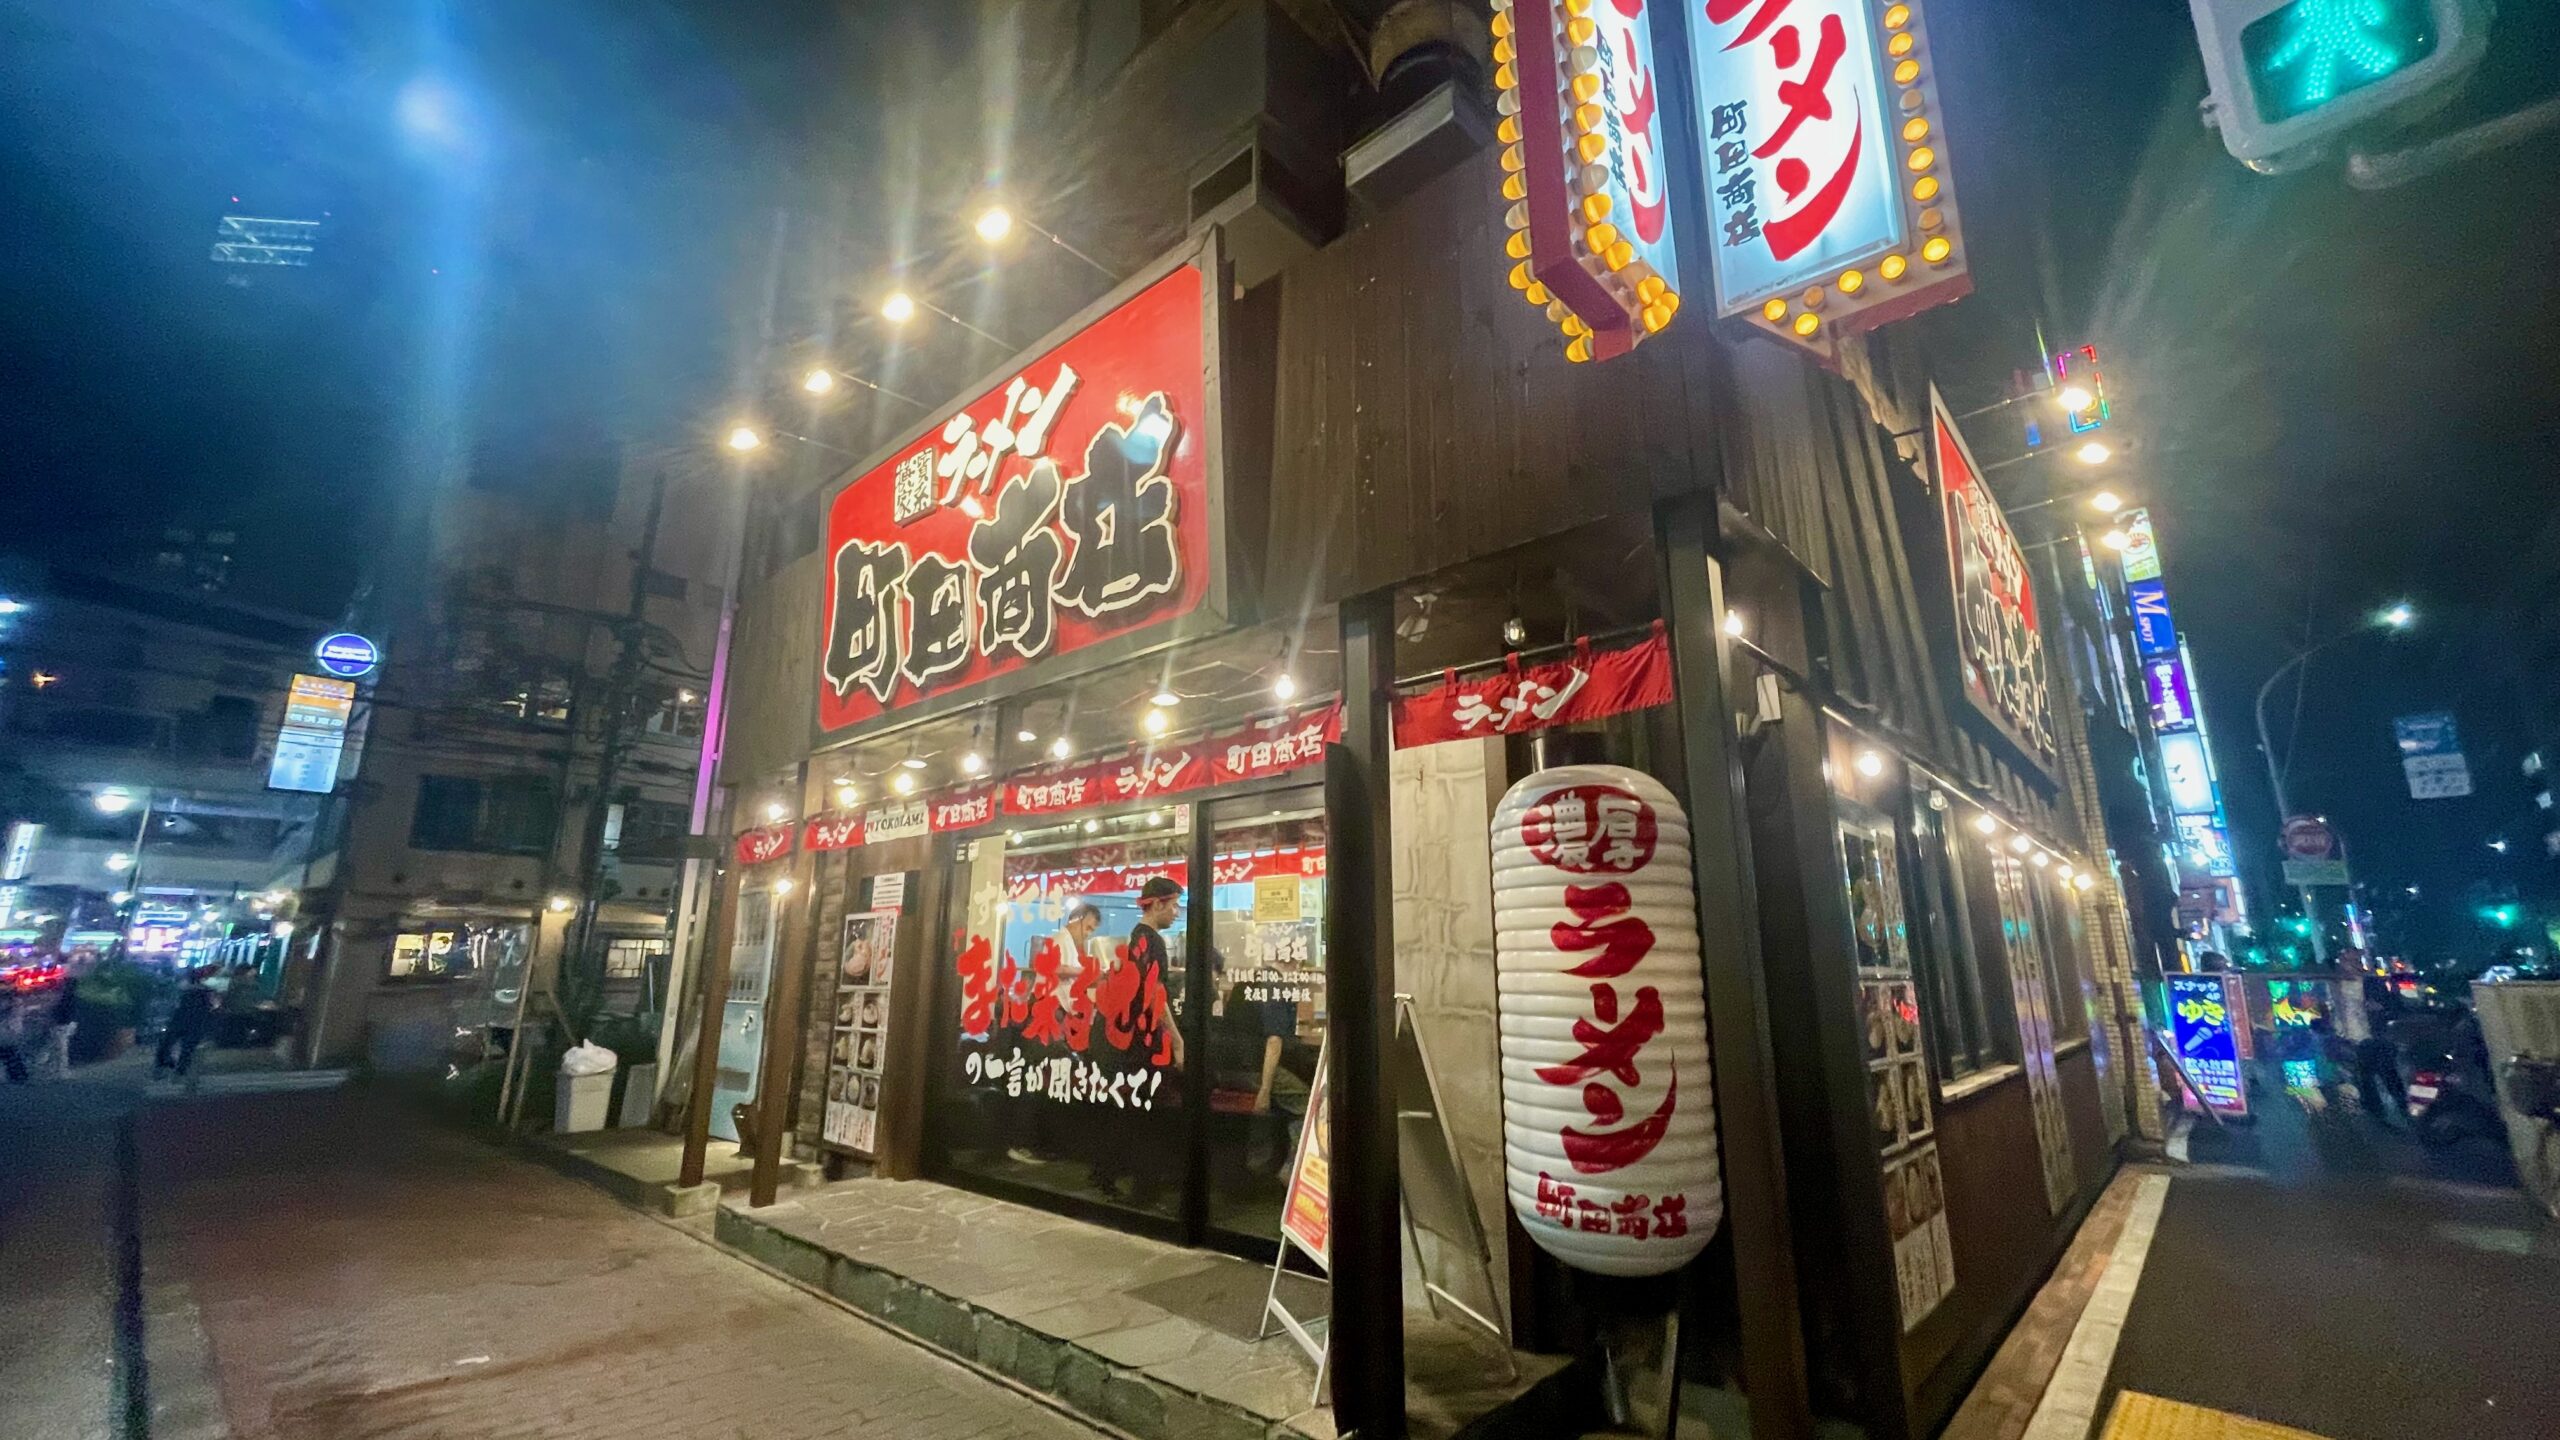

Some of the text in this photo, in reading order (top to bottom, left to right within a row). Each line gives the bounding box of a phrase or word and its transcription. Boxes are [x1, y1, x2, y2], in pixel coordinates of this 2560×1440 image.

[1711, 99, 1760, 248] 町田商店
[938, 364, 1078, 506] ラーメン
[824, 390, 1178, 703] 町田商店
[2132, 590, 2169, 617] M
[2139, 616, 2156, 644] SPOT
[1453, 665, 1589, 731] ラーメン
[1115, 751, 1191, 795] ラーメン
[1226, 723, 1325, 775] 町田商店
[1016, 777, 1087, 810] 町田商店
[817, 820, 856, 848] ラーメン
[1535, 789, 1645, 871] 濃厚
[2173, 980, 2219, 992] スナック
[1533, 882, 1678, 1173] ラーメン
[2177, 998, 2226, 1027] ゆき
[1534, 1171, 1688, 1241] 町田商店
